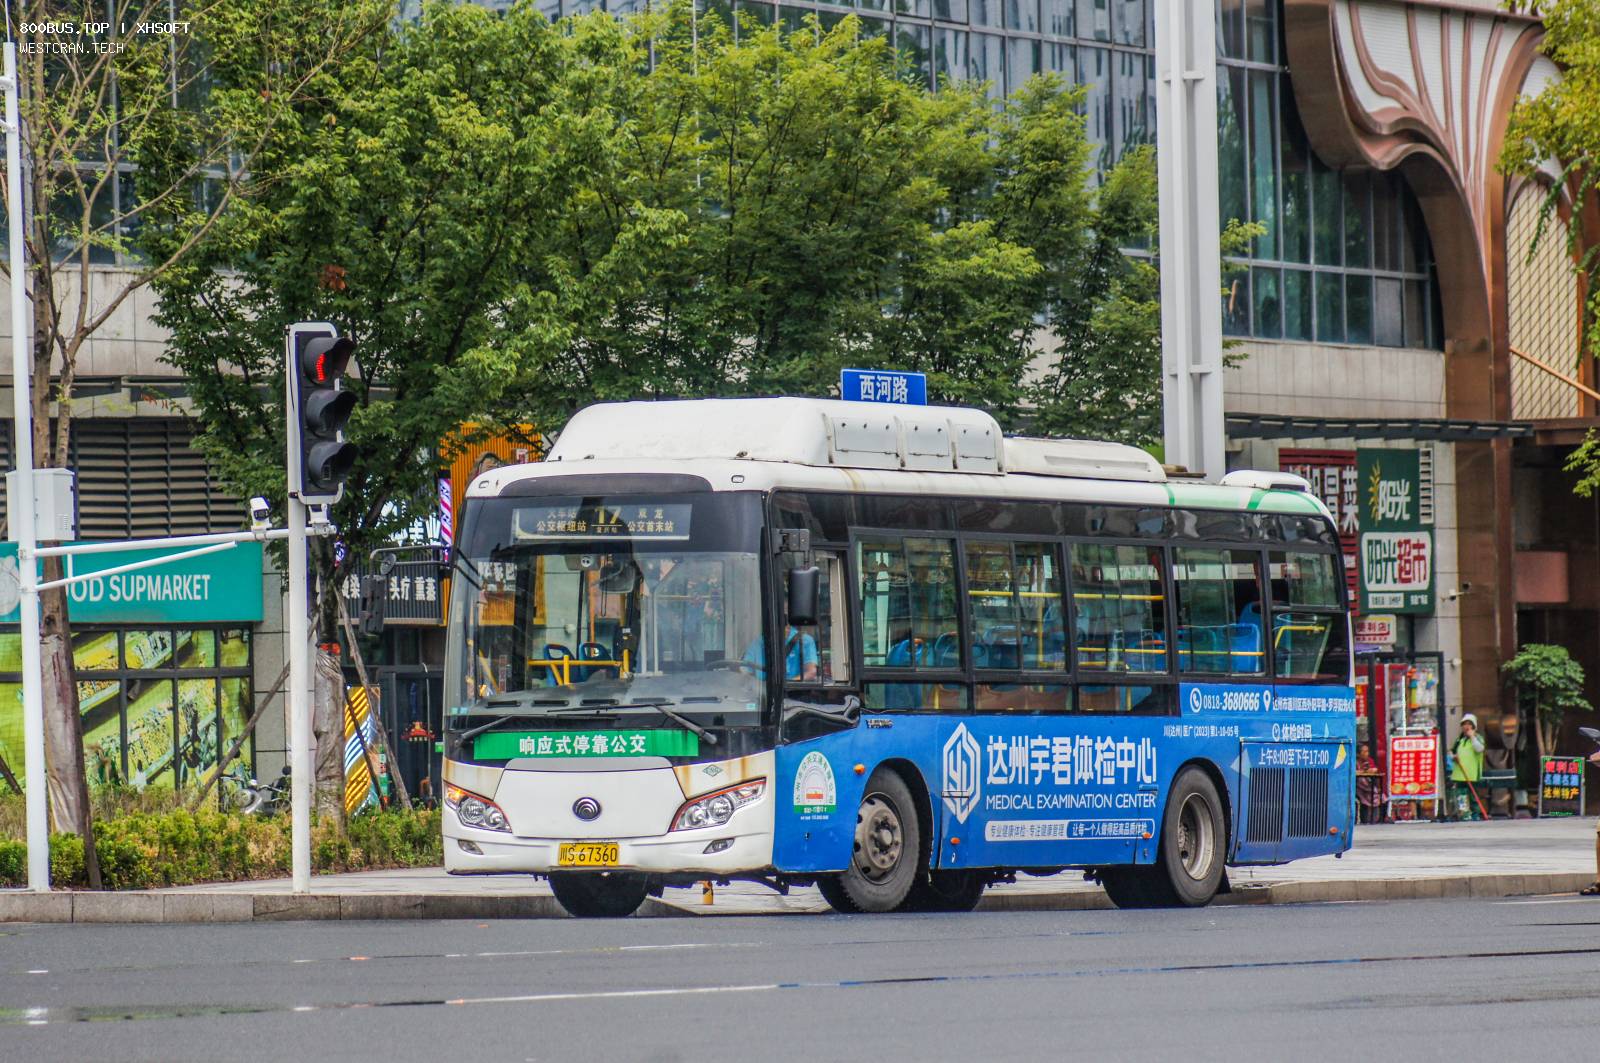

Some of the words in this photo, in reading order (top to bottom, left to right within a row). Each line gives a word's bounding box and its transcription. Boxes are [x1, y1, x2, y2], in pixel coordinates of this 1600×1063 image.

[859, 375, 909, 403] 西河路
[1378, 479, 1411, 521] 阳光
[536, 520, 587, 532] 公交枢纽站
[594, 507, 623, 524] 17
[627, 520, 674, 532] 公交首末站
[1367, 538, 1427, 585] 阳光超市
[64, 576, 104, 603] OD
[109, 574, 211, 602] SUPMARKET
[390, 575, 411, 601] 头疗
[1203, 692, 1260, 712] 0818-3680666
[1282, 723, 1313, 742] 体检时间
[519, 734, 647, 755] 响应式停靠公交
[986, 735, 1157, 785] 达州宇君体检中心
[986, 795, 1035, 810] MEDICAL
[1037, 793, 1113, 809] EXAMINATION
[1115, 793, 1157, 809] CENTER
